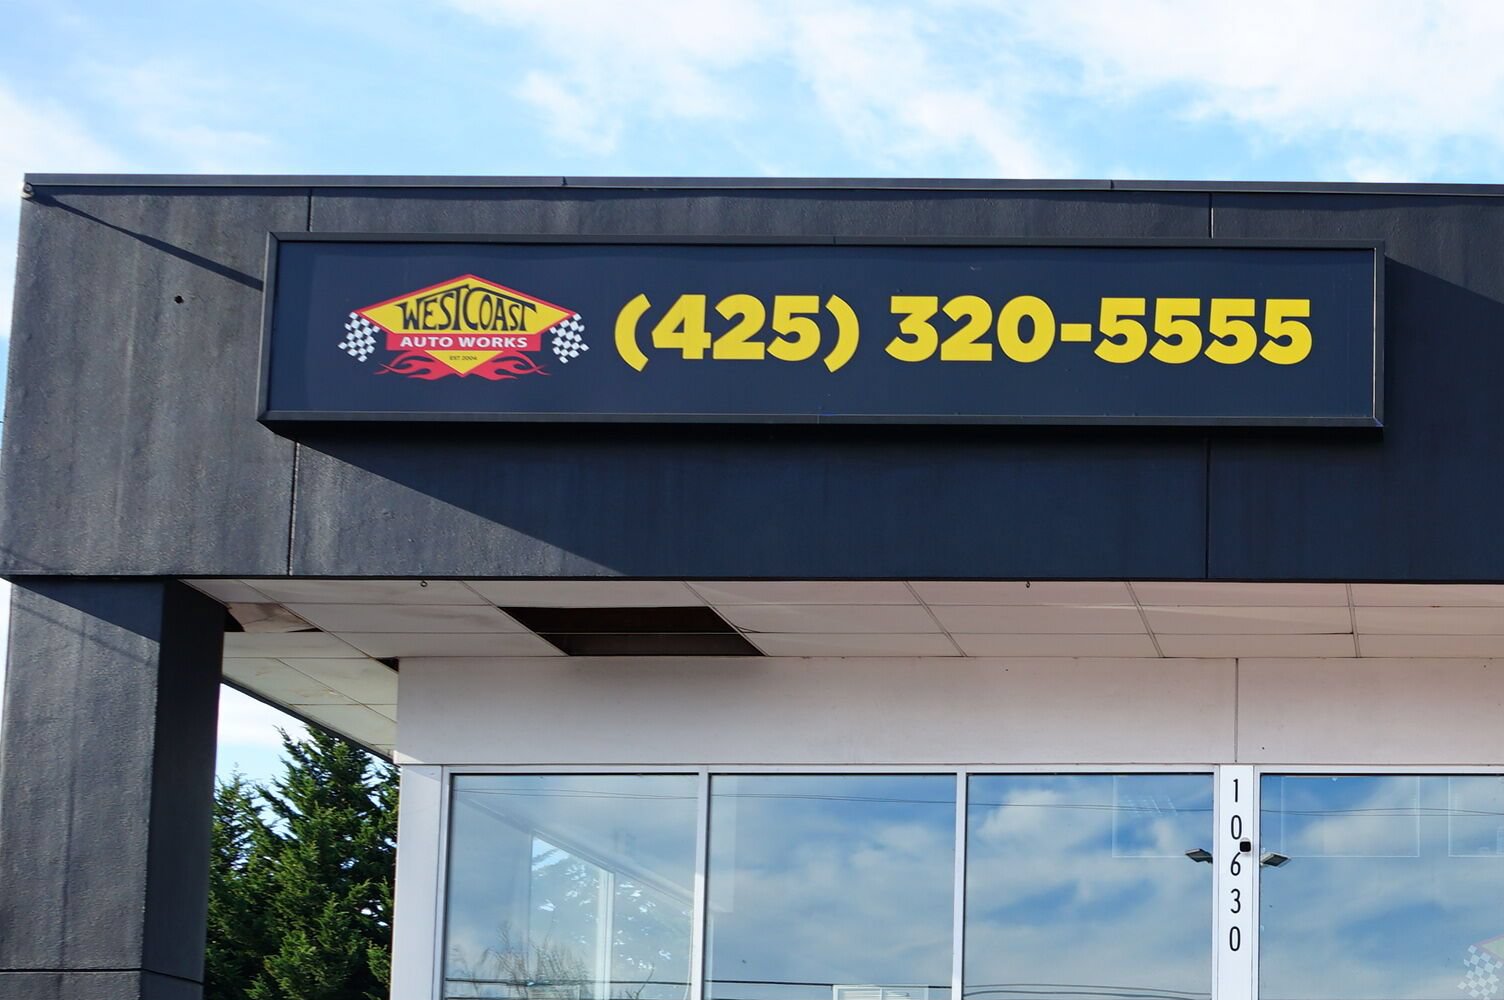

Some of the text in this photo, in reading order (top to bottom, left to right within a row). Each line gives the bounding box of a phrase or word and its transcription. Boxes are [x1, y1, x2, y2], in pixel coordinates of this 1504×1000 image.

[400, 336, 528, 348] AUTO WORKS
[614, 294, 1313, 373] (425) 320-5555
[1229, 778, 1243, 951] 10630
